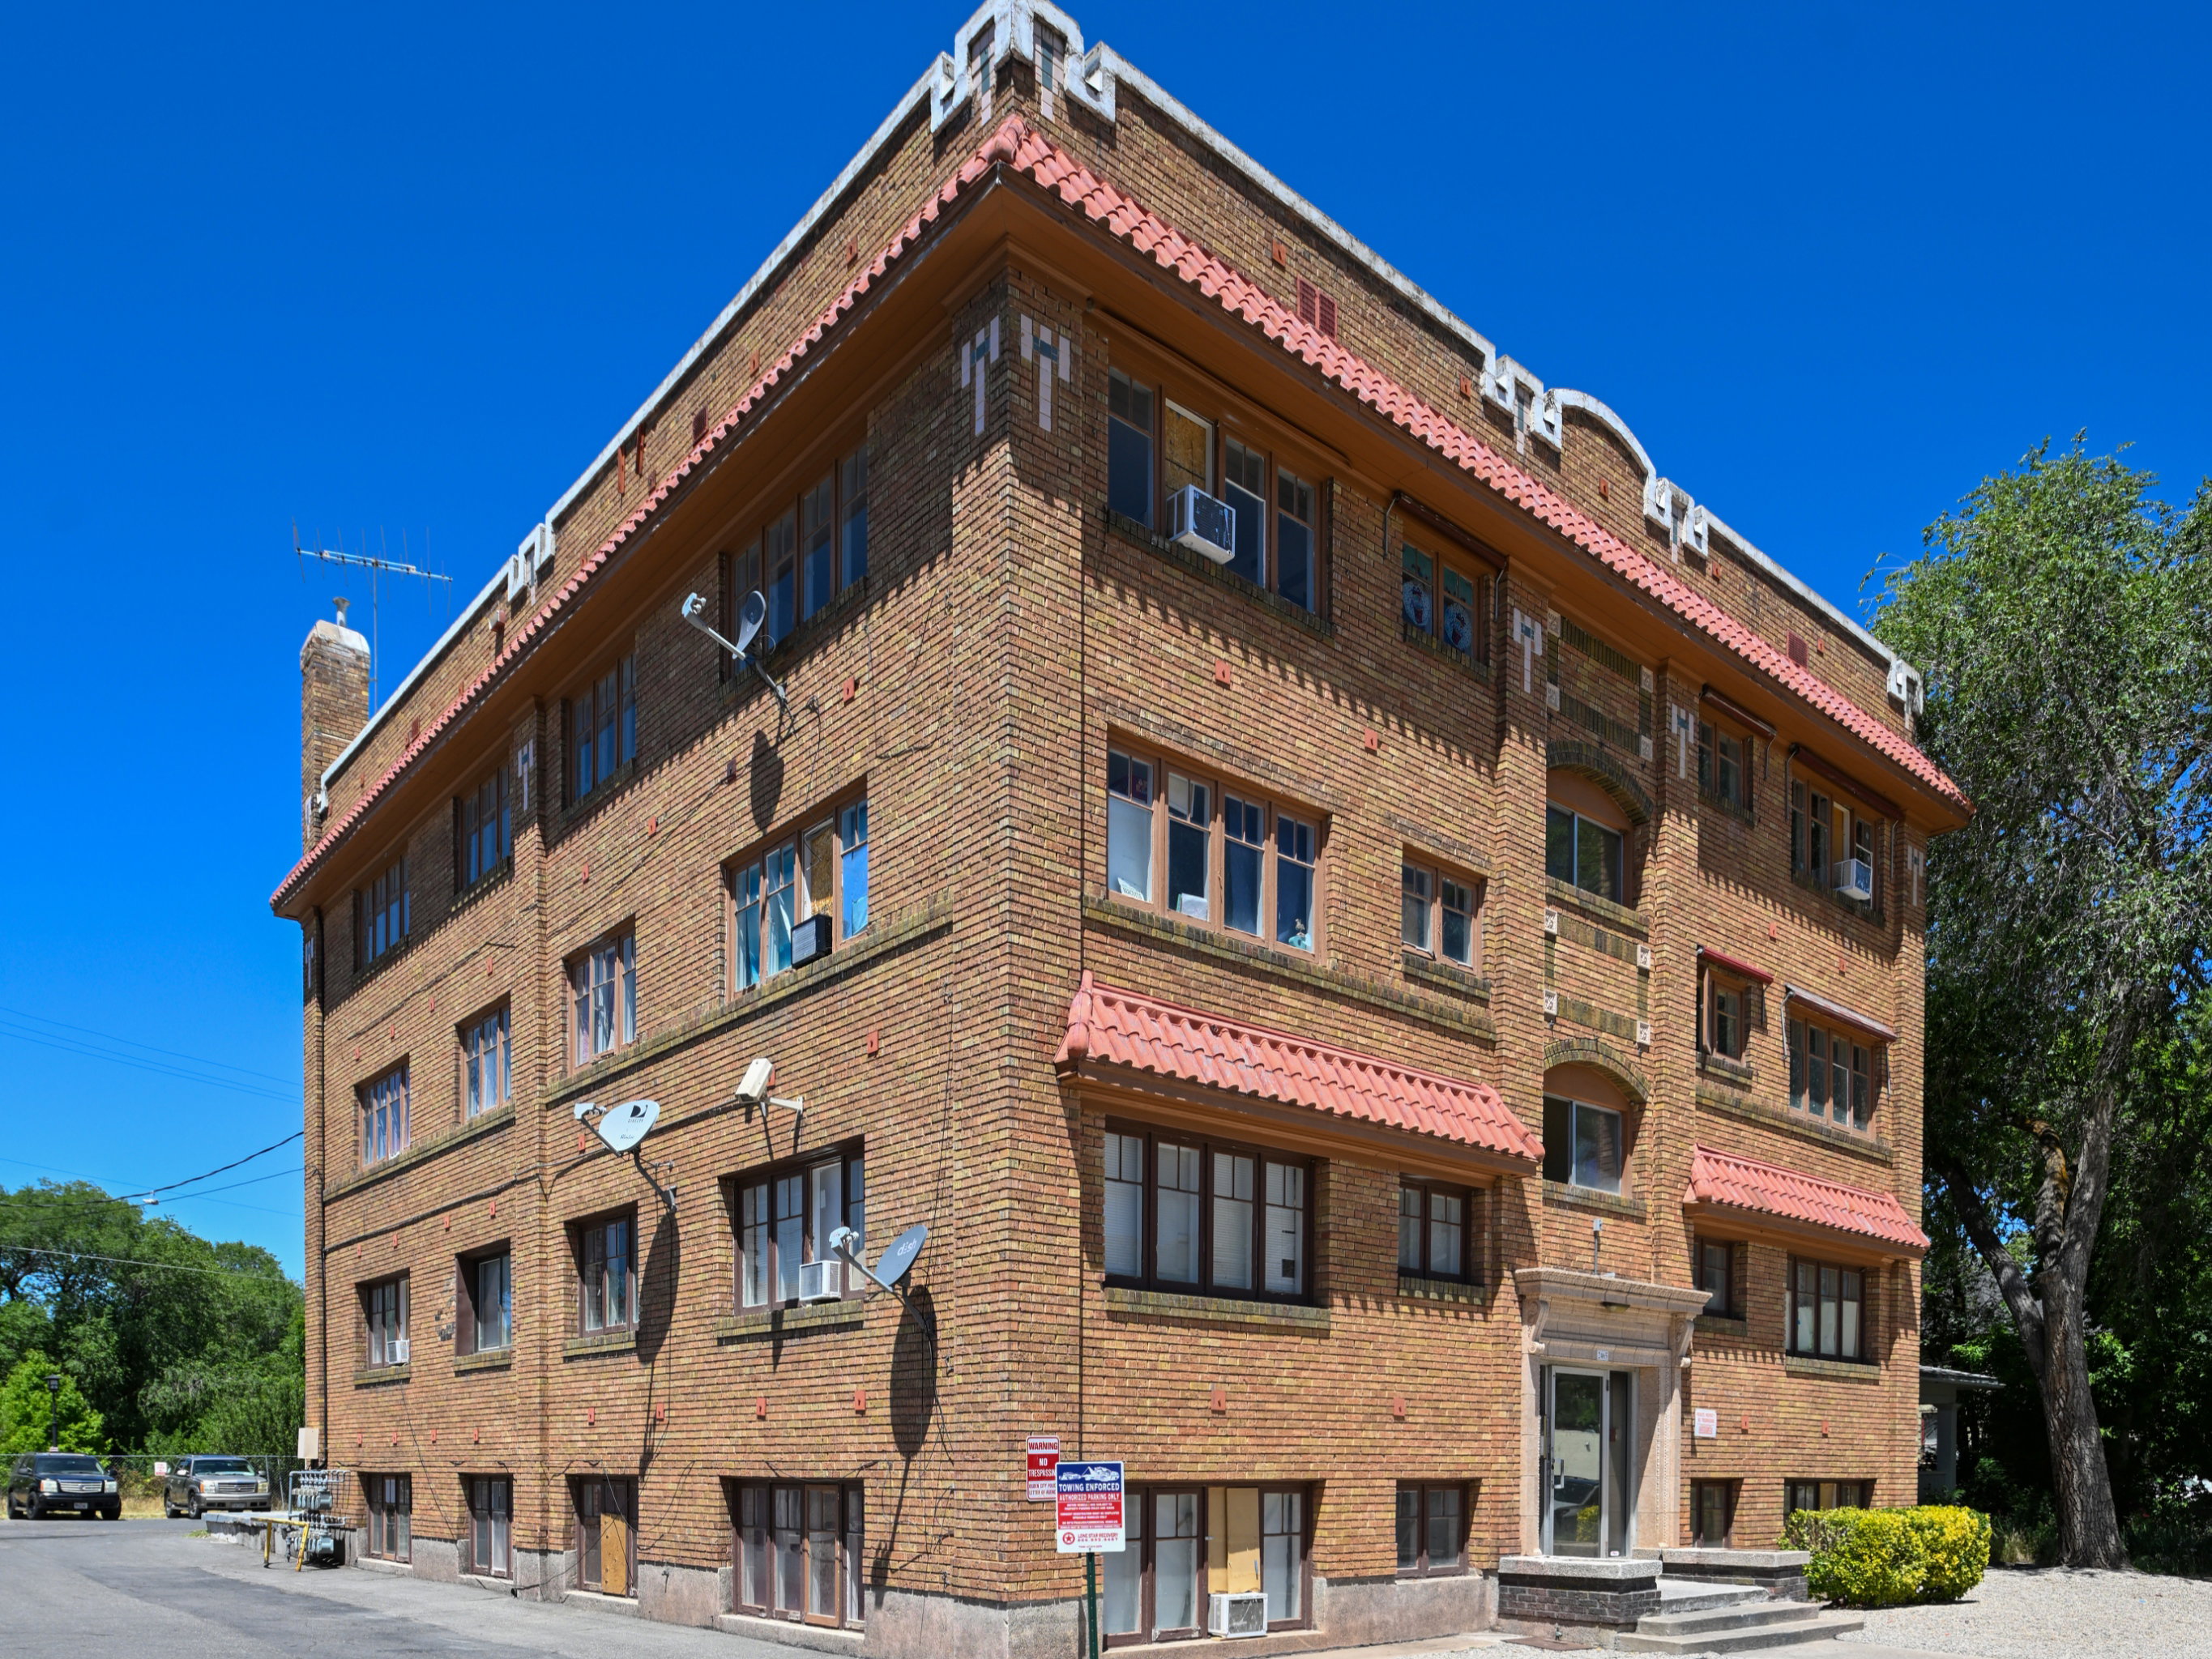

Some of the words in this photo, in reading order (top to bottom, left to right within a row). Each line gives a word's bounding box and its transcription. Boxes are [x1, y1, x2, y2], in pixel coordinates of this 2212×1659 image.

[897, 1238, 917, 1256] dish
[1028, 1441, 1058, 1450] WARNING
[1039, 1457, 1048, 1466] NO
[1028, 1469, 1056, 1477] TRESPASSIN
[1058, 1483, 1084, 1491] TOWING
[1086, 1482, 1120, 1491] ENFORCED
